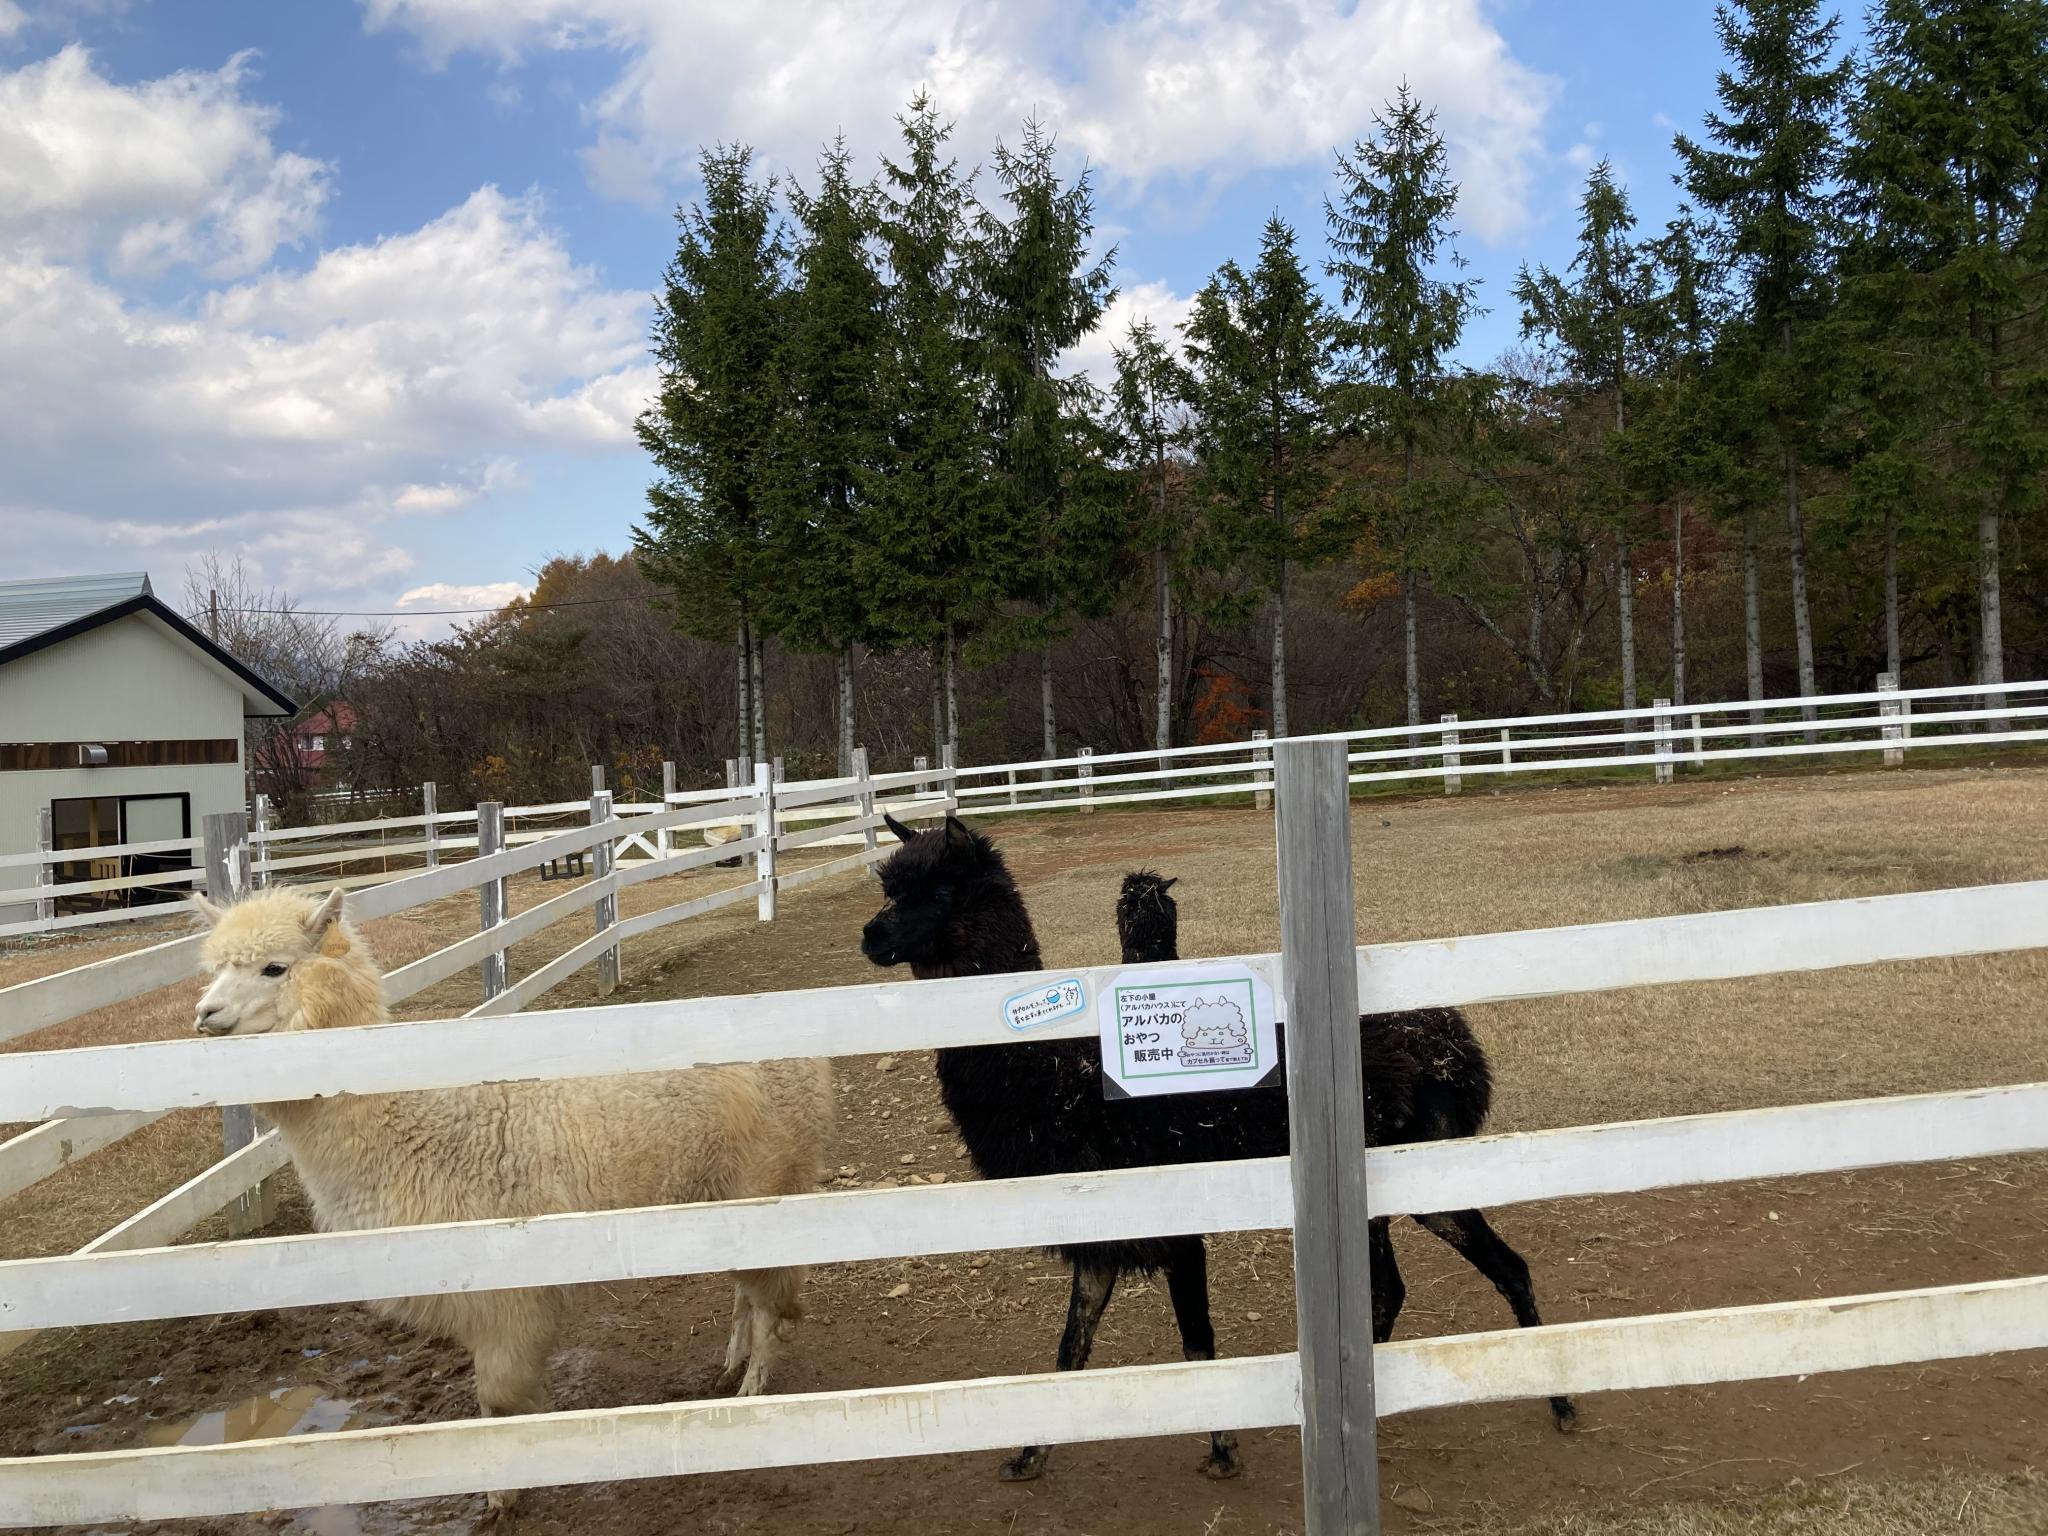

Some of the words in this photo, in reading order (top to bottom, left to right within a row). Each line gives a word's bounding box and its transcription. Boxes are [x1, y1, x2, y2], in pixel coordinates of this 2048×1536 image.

[1120, 993, 1156, 1002] 左下の小屋
[1122, 1012, 1183, 1028] アルパカの
[1124, 1032, 1160, 1045] おやつ
[1134, 1048, 1174, 1063] 販売中
